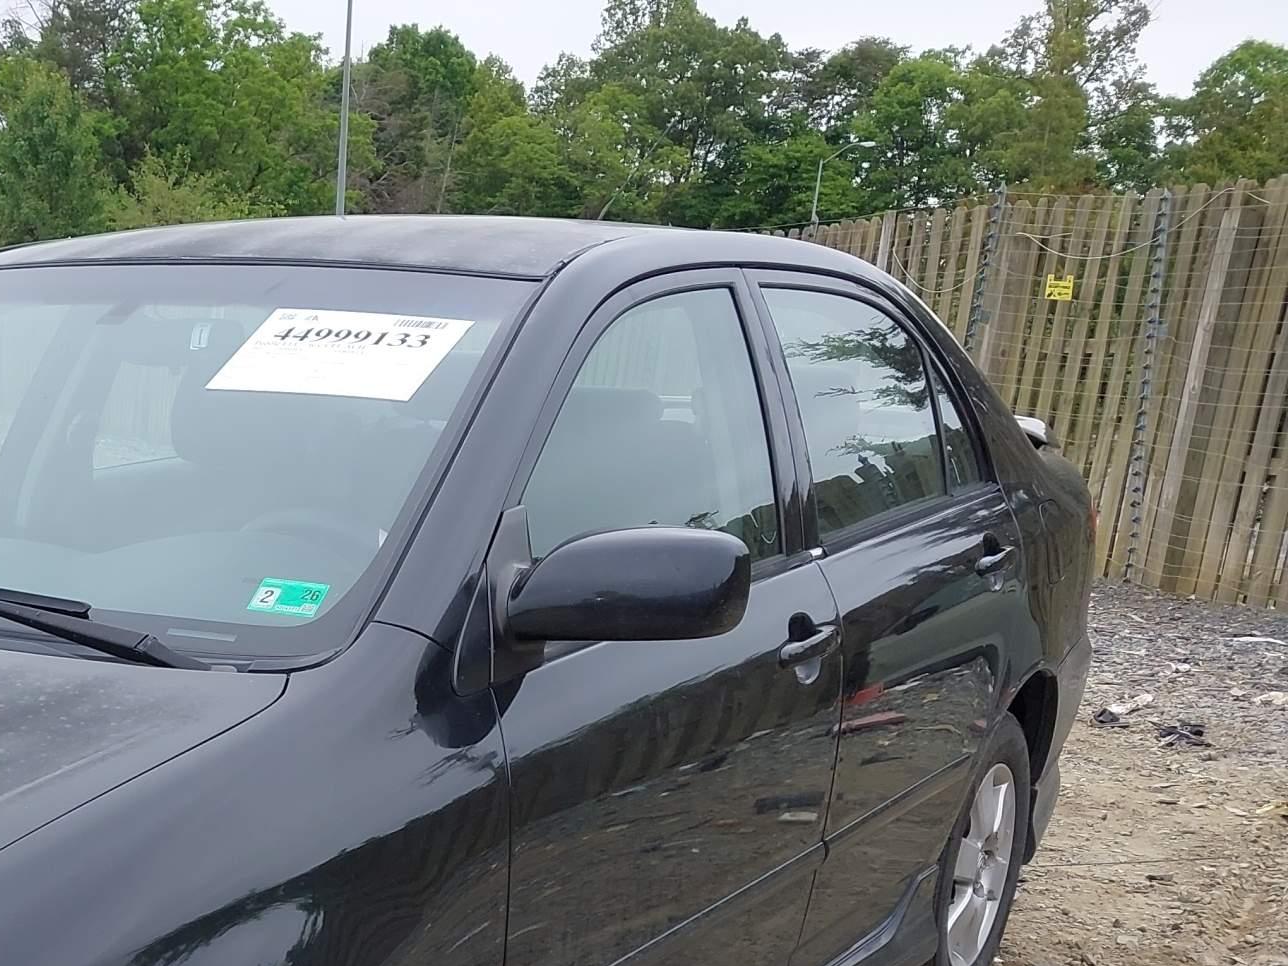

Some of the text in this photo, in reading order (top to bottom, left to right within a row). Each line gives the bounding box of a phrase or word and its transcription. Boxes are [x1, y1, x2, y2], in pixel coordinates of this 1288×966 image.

[273, 326, 431, 349] 44999133
[260, 588, 321, 604] 2 26
